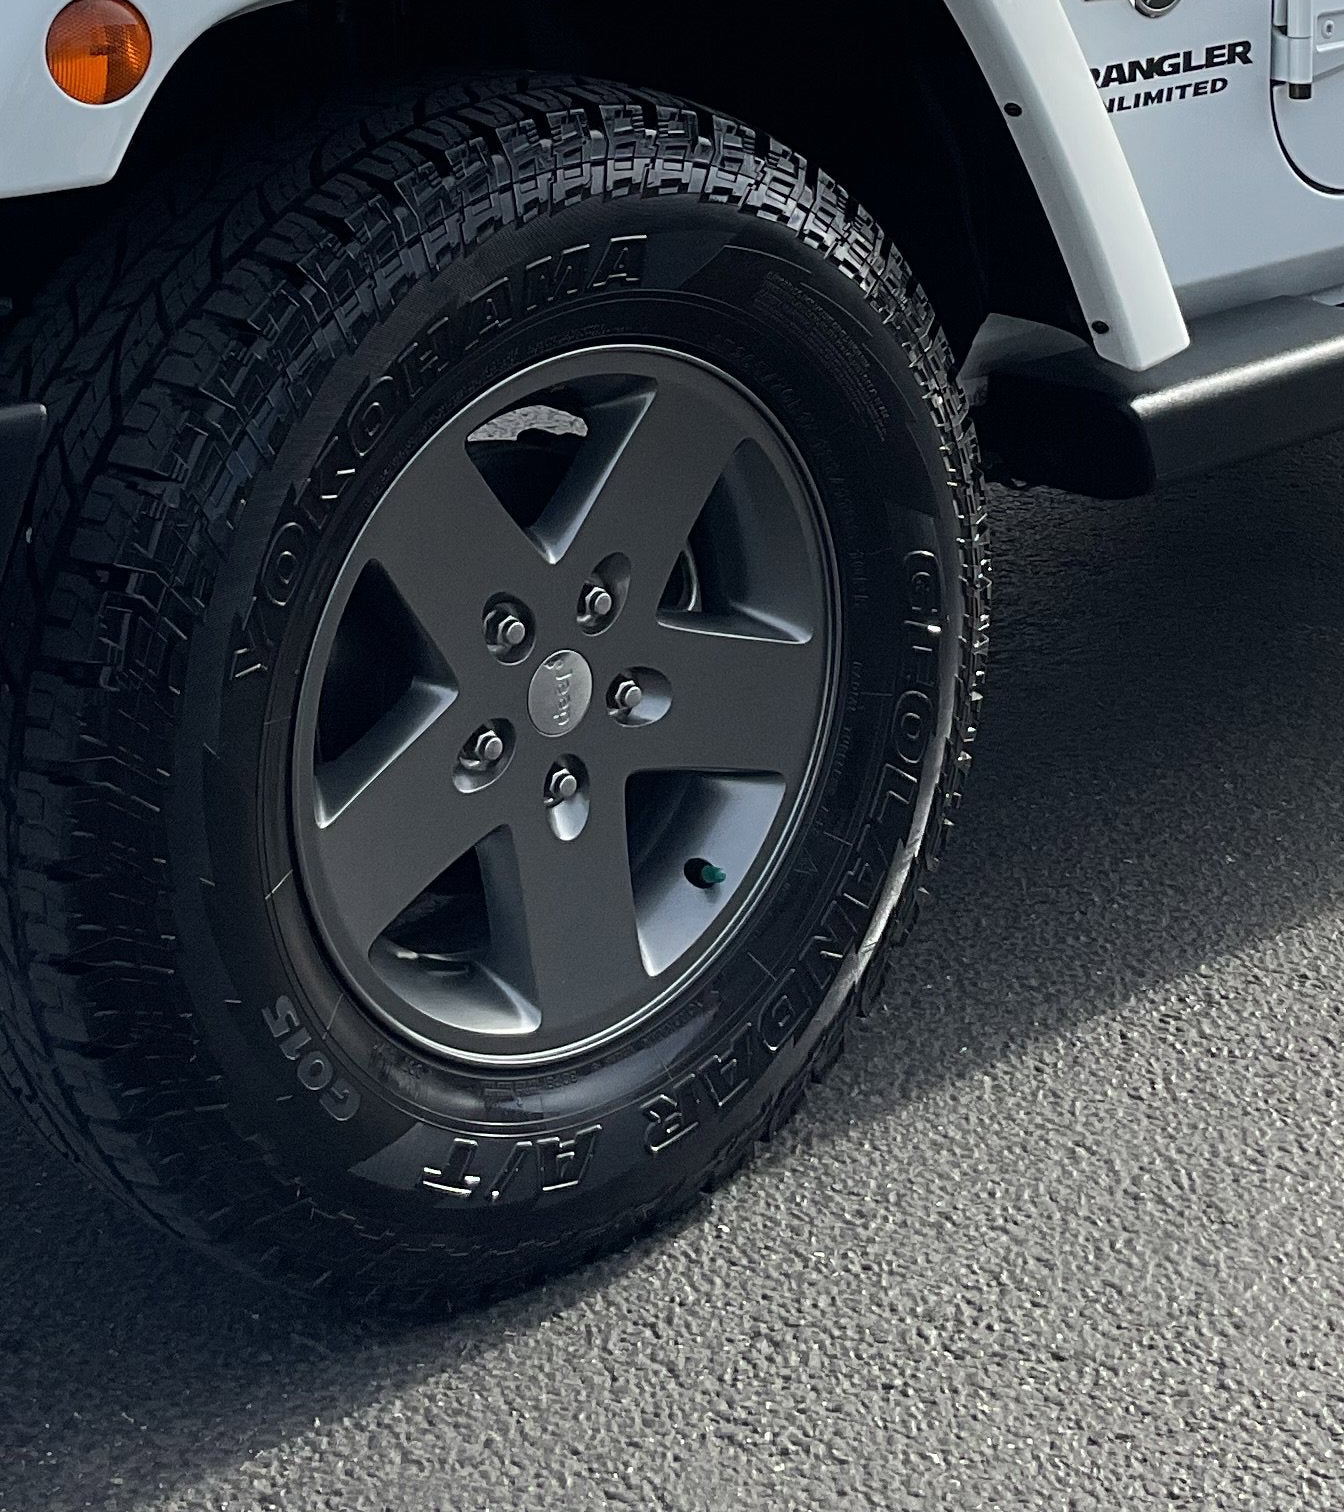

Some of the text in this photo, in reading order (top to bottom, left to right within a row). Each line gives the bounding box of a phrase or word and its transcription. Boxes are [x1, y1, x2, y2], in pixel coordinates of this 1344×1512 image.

[229, 234, 649, 681] YOKOHAMA
[261, 994, 362, 1122] G015
[421, 1123, 603, 1199] A/T
